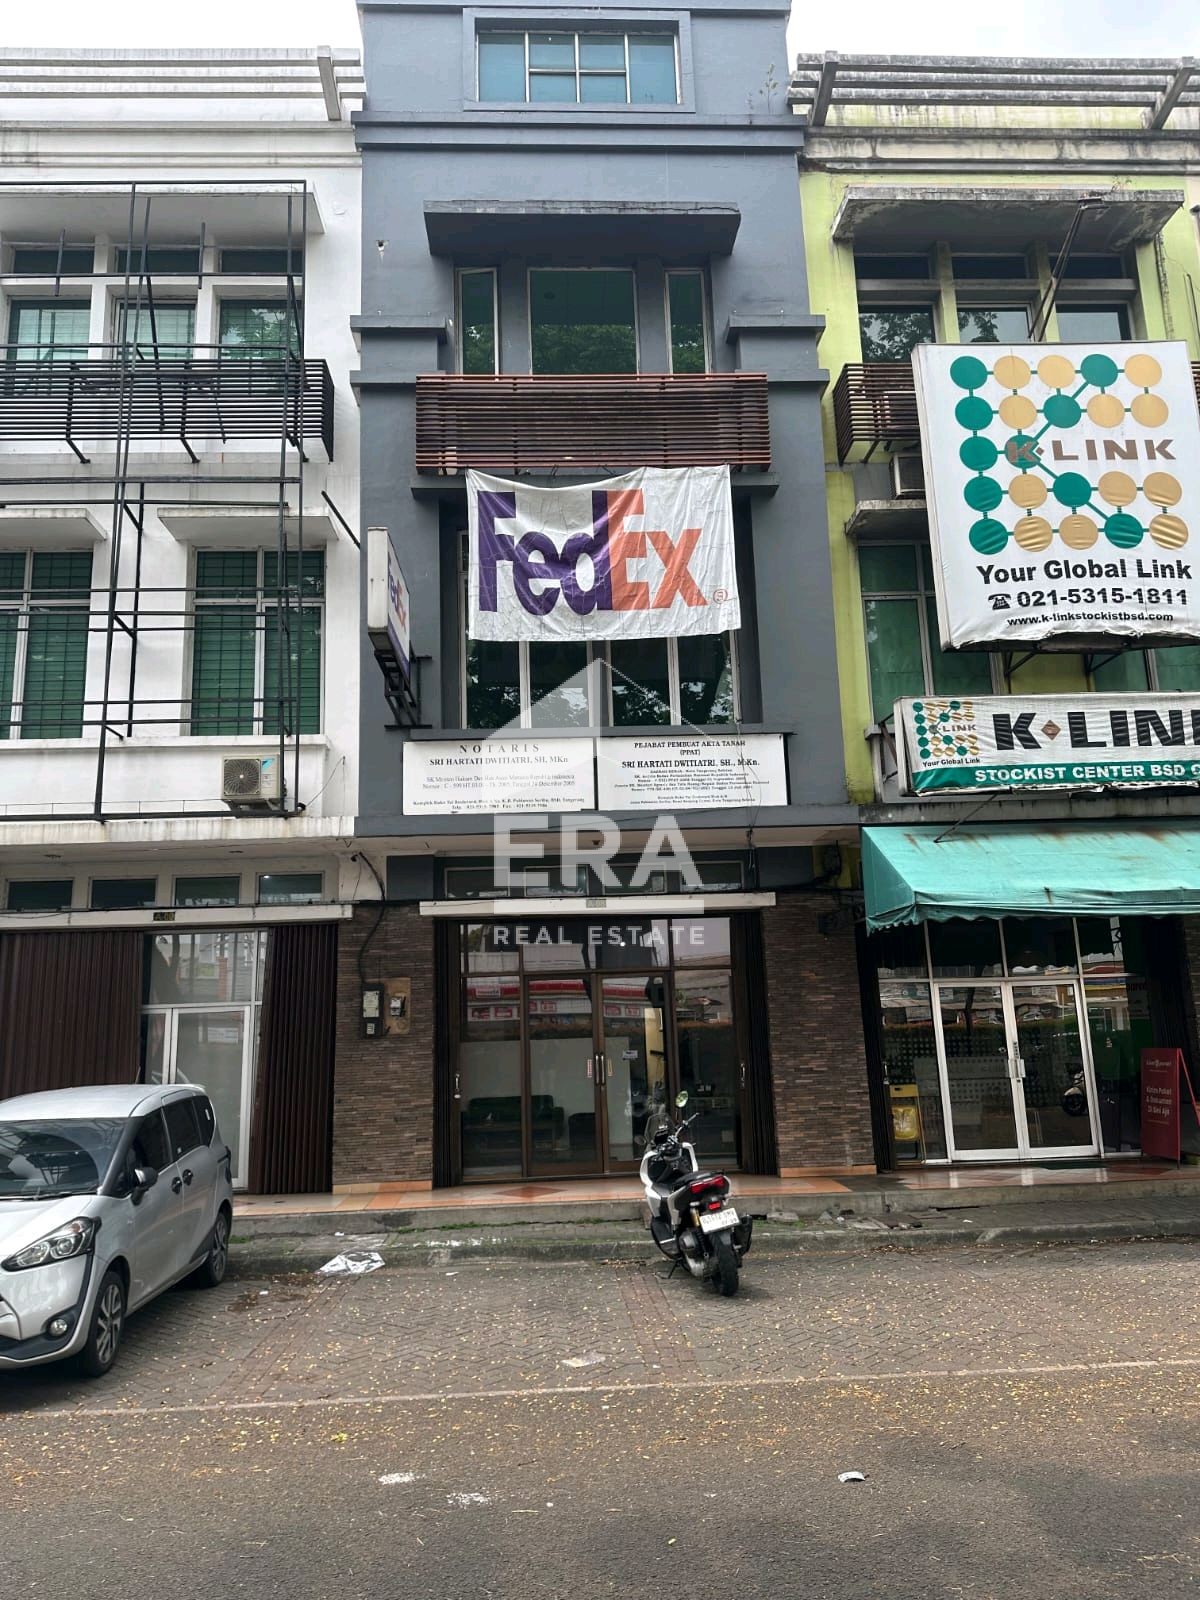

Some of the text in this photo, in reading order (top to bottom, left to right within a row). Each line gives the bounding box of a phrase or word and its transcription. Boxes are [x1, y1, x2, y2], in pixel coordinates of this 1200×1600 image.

[477, 488, 709, 616] FedEx
[976, 558, 1193, 585] Your Global Link
[1016, 587, 1188, 609] 021-5315-1811
[1006, 611, 1174, 629] www.k-linkstockistbsd.com
[459, 743, 539, 753] NOTARIS
[633, 741, 665, 749] PEJABAT
[429, 758, 444, 766] SRI
[446, 757, 484, 766] HARTATI
[621, 761, 635, 769] SRI
[637, 760, 673, 768] HARTATI
[923, 757, 981, 768] Your Global Link
[975, 767, 1067, 782] STOCKIST
[1072, 764, 1145, 779] CENTER
[1150, 764, 1186, 777] BSD
